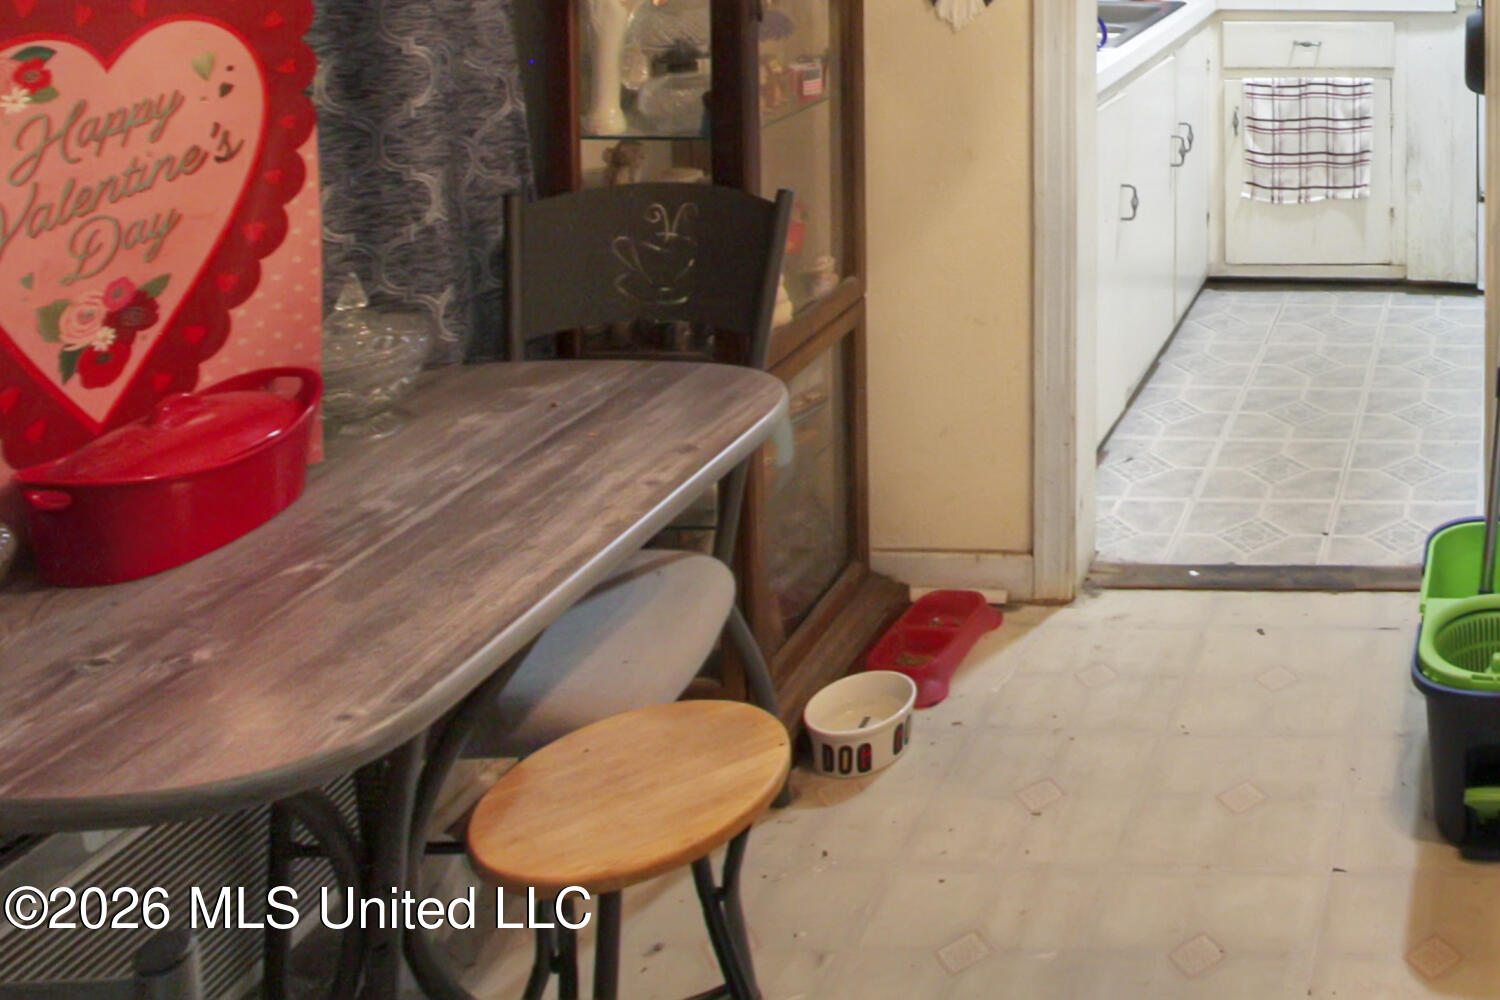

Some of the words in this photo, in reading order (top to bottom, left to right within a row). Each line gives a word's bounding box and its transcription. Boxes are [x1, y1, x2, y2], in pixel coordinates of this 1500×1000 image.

[7, 89, 185, 187] Happy
[0, 121, 246, 260] Valentine's
[60, 207, 183, 286] Day
[821, 743, 872, 775] DOG
